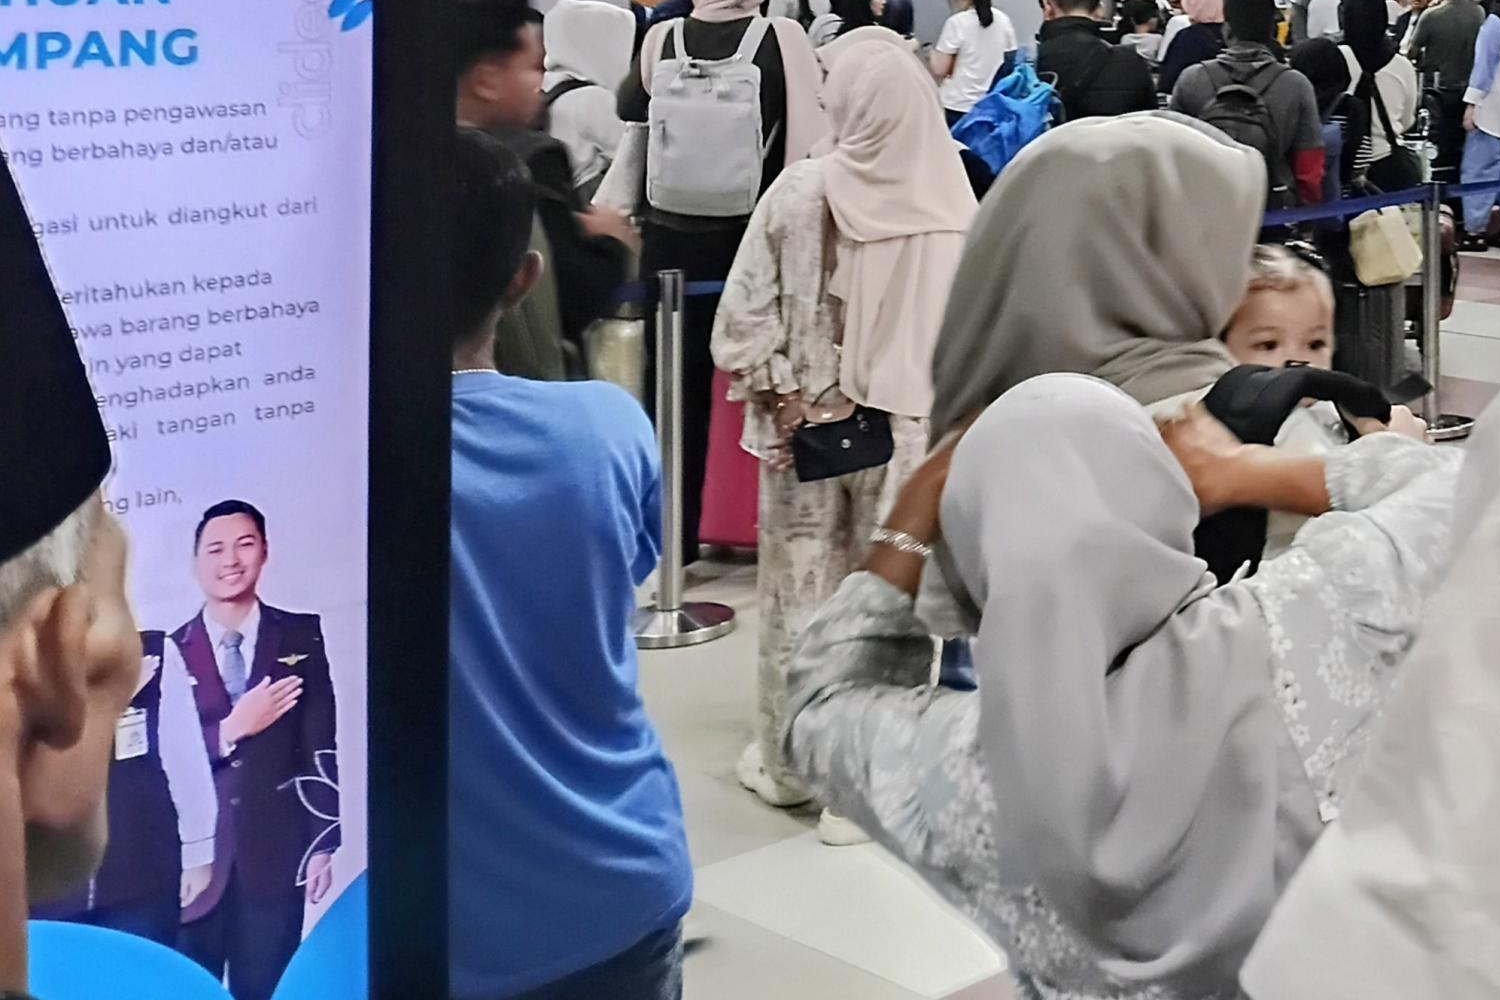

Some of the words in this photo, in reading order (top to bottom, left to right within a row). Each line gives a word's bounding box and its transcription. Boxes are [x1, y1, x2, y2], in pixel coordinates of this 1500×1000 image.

[47, 108, 116, 129] tanpa
[124, 101, 266, 125] pengawasan
[51, 140, 173, 163] berbahaya
[180, 131, 278, 154] dan/atau
[89, 209, 158, 232] untuk
[168, 200, 268, 226] diangkut
[276, 196, 318, 217] dari
[62, 278, 186, 305] eritahukan
[193, 269, 273, 295] kepada
[120, 313, 201, 335] barang
[207, 299, 320, 326] berbahaya
[114, 351, 172, 376] yang
[178, 341, 242, 364] dapat
[263, 364, 316, 387] anda
[157, 411, 236, 435] tangan
[254, 400, 316, 422] tanpa
[136, 488, 183, 509] lain,
